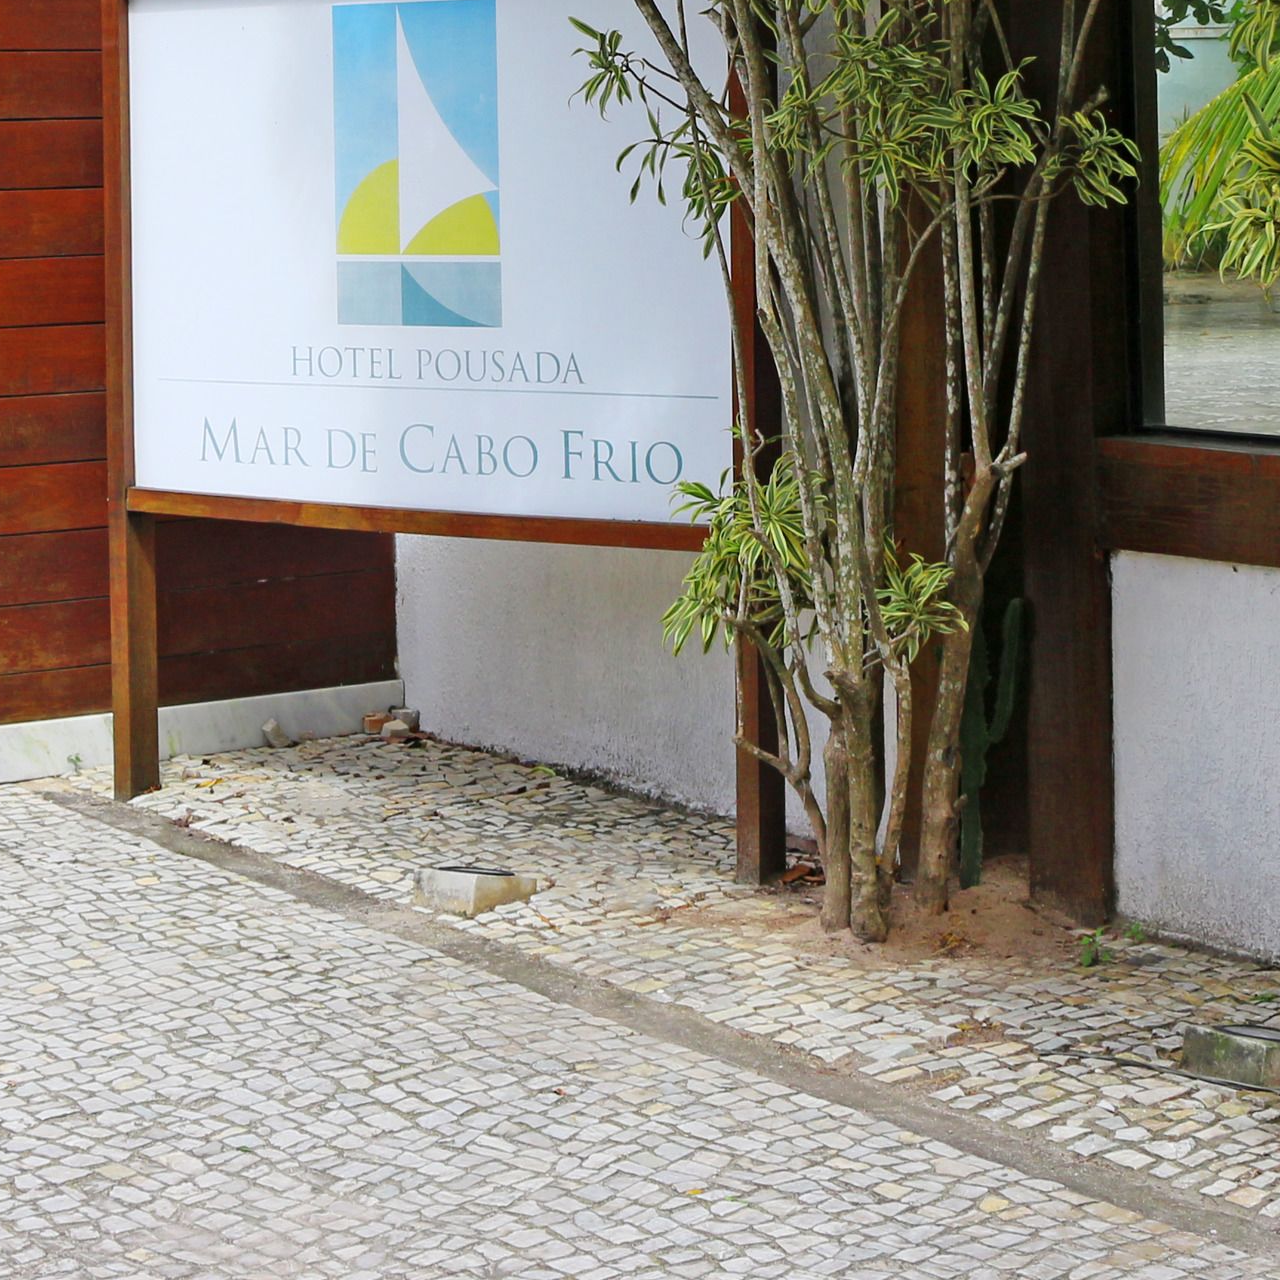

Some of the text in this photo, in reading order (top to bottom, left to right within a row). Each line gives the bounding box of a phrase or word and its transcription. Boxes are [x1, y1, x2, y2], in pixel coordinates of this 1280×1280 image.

[291, 346, 586, 385] HOTEL POUSADA
[200, 416, 684, 485] MAR DE CABO FRIO
